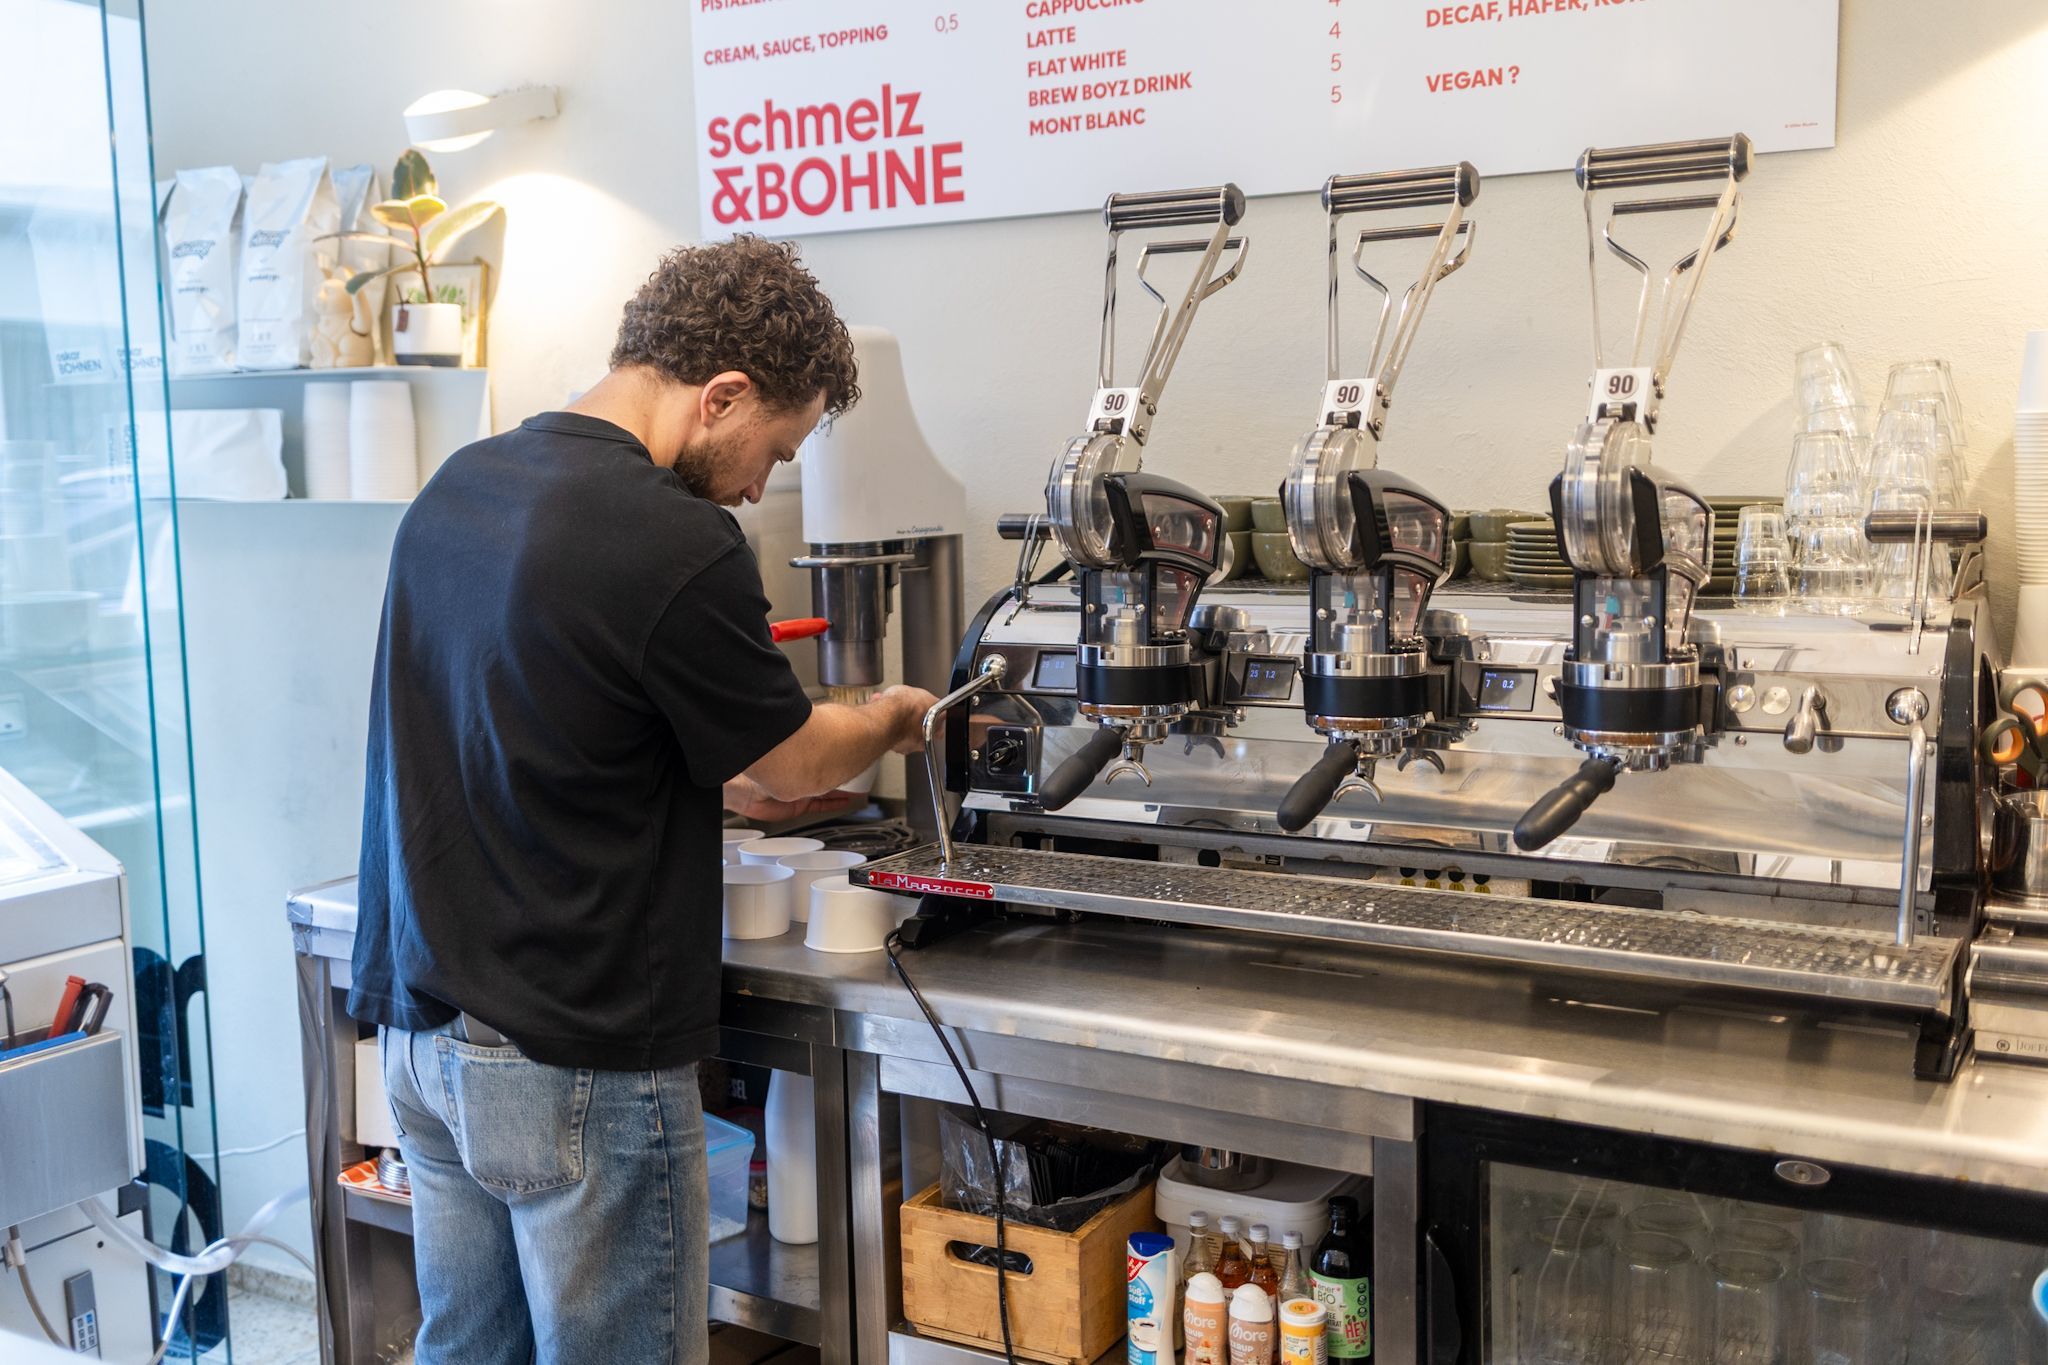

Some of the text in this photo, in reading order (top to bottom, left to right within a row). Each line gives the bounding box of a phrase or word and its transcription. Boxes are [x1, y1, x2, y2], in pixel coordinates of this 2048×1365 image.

[935, 14, 959, 34] 0,5
[1426, 1, 1502, 28] DECAF,
[1027, 26, 1076, 48] LATTE
[1328, 21, 1341, 39] 4
[704, 24, 889, 66] CREAM, SAUCE, TOPPING
[1028, 50, 1127, 78] FLAT WHITE
[1330, 53, 1342, 72] 5
[1029, 71, 1193, 107] BREW BOYZ DRINK
[1426, 67, 1503, 93] VEGAN
[1330, 84, 1342, 103] 5
[708, 83, 924, 158] schmelz
[1030, 108, 1146, 136] MONT BLANC
[712, 141, 965, 225] &BOHNE
[1336, 385, 1360, 404] 90
[1608, 374, 1634, 394] 90
[1104, 394, 1125, 411] 90
